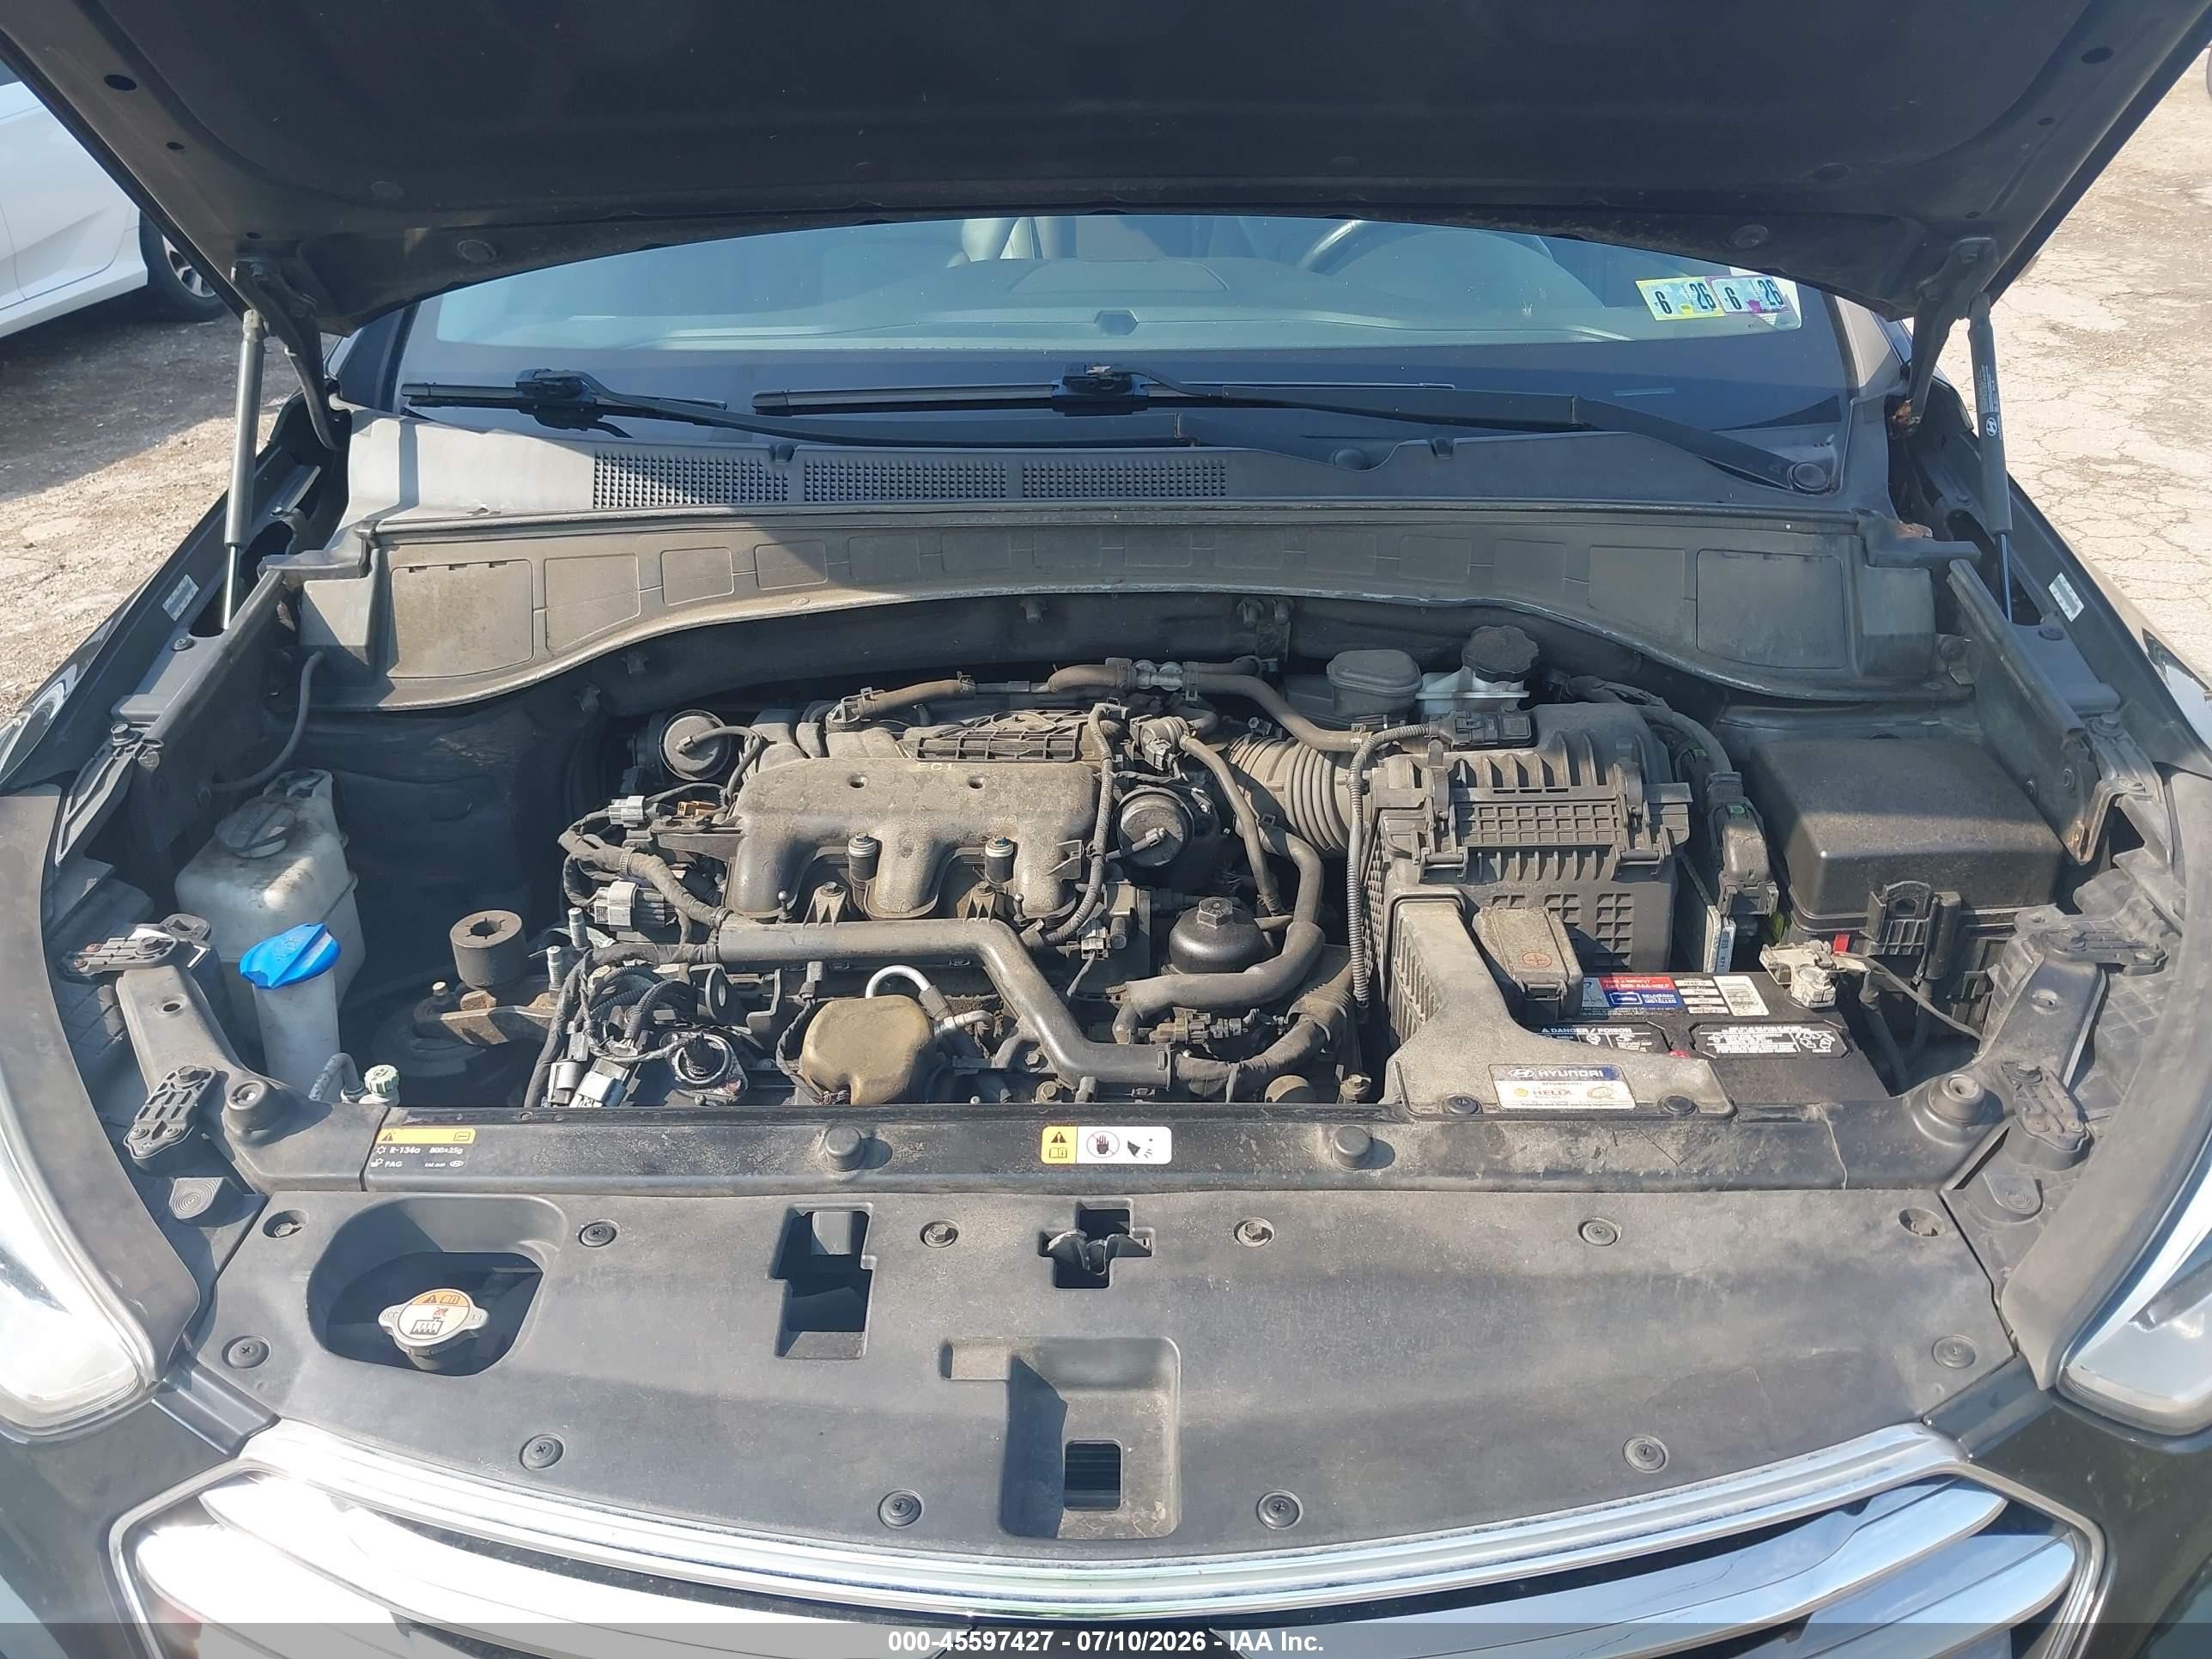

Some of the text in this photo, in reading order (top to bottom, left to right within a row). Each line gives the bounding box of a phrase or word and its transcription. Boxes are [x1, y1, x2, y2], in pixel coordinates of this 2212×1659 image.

[1654, 290, 1673, 314] 6
[1689, 283, 1717, 309] 26
[1723, 286, 1742, 310] 6
[1757, 279, 1784, 306] 26
